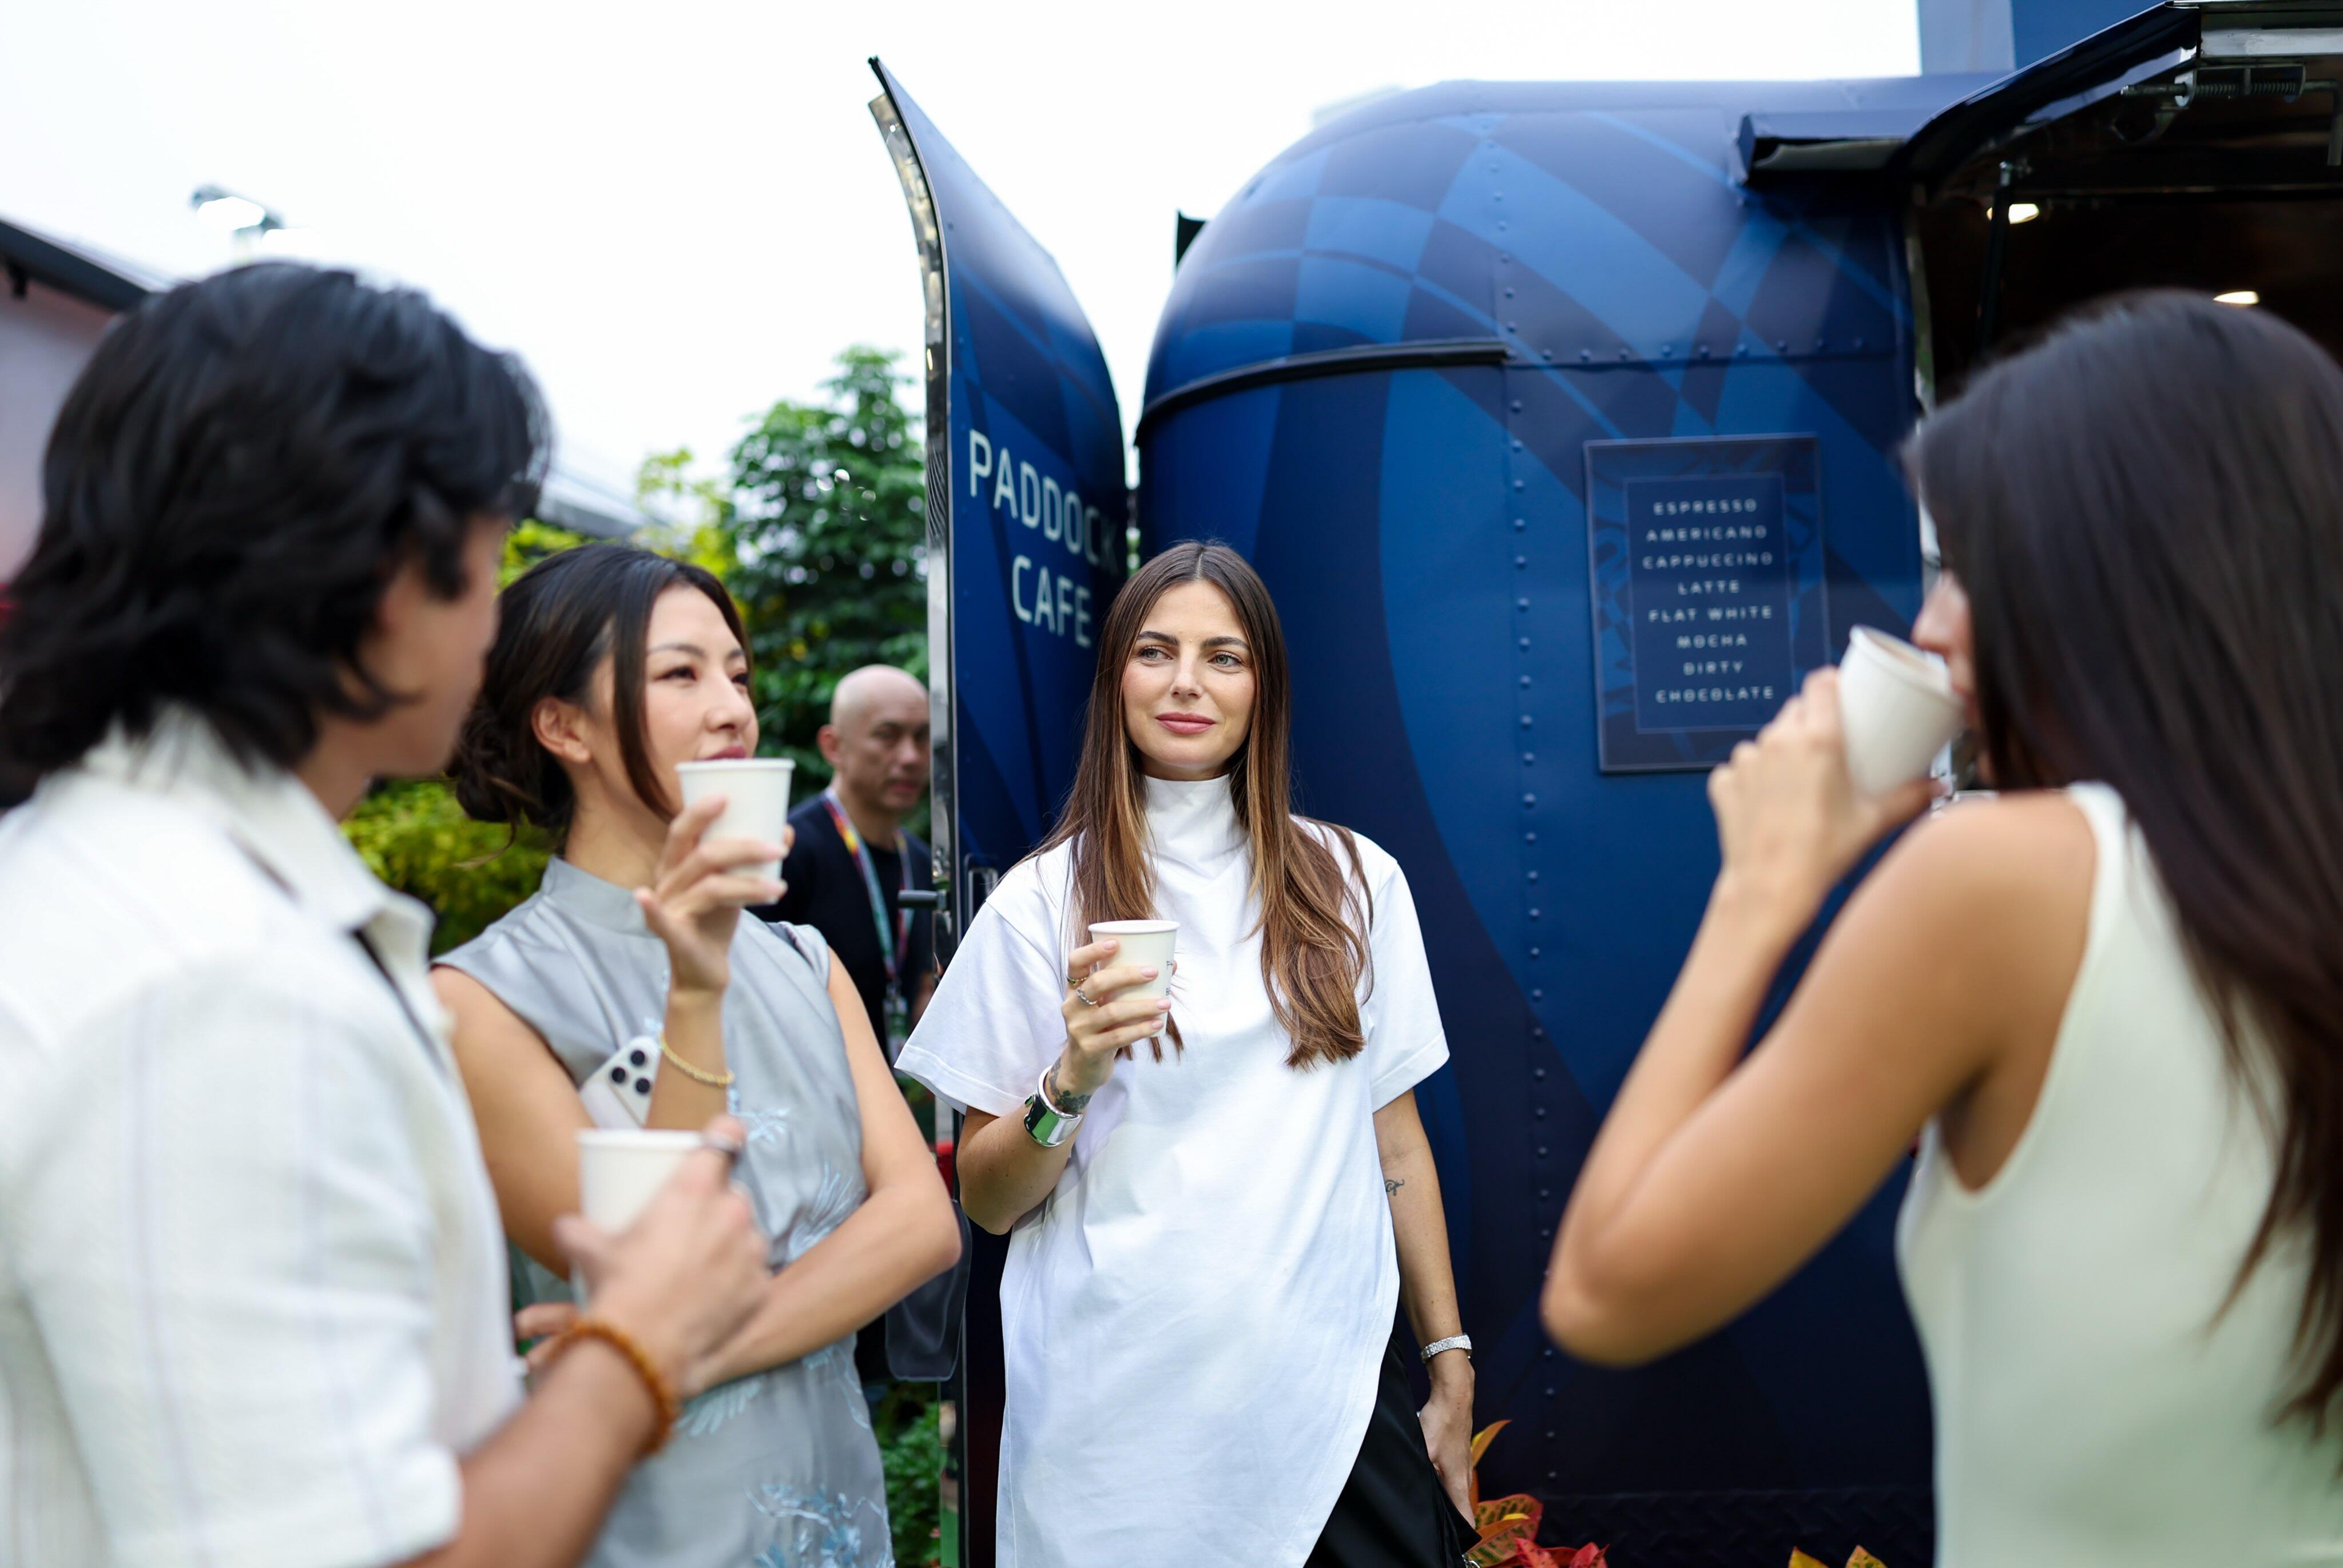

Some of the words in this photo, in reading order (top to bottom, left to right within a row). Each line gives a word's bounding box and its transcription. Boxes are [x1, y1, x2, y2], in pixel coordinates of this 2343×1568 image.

[1653, 498, 1757, 515] ESPRESSO
[1646, 525, 1767, 542] AMERICANO
[1642, 551, 1773, 569] CAPPUCCINO
[1677, 579, 1740, 595] LATTE
[1012, 554, 1091, 648] CAFE
[1648, 608, 1697, 622] FLAT
[1707, 605, 1772, 620] WHITE
[1676, 633, 1748, 648] MOCHA
[1683, 660, 1743, 676] DIRTY
[1655, 686, 1774, 703] CHOCOLATE
